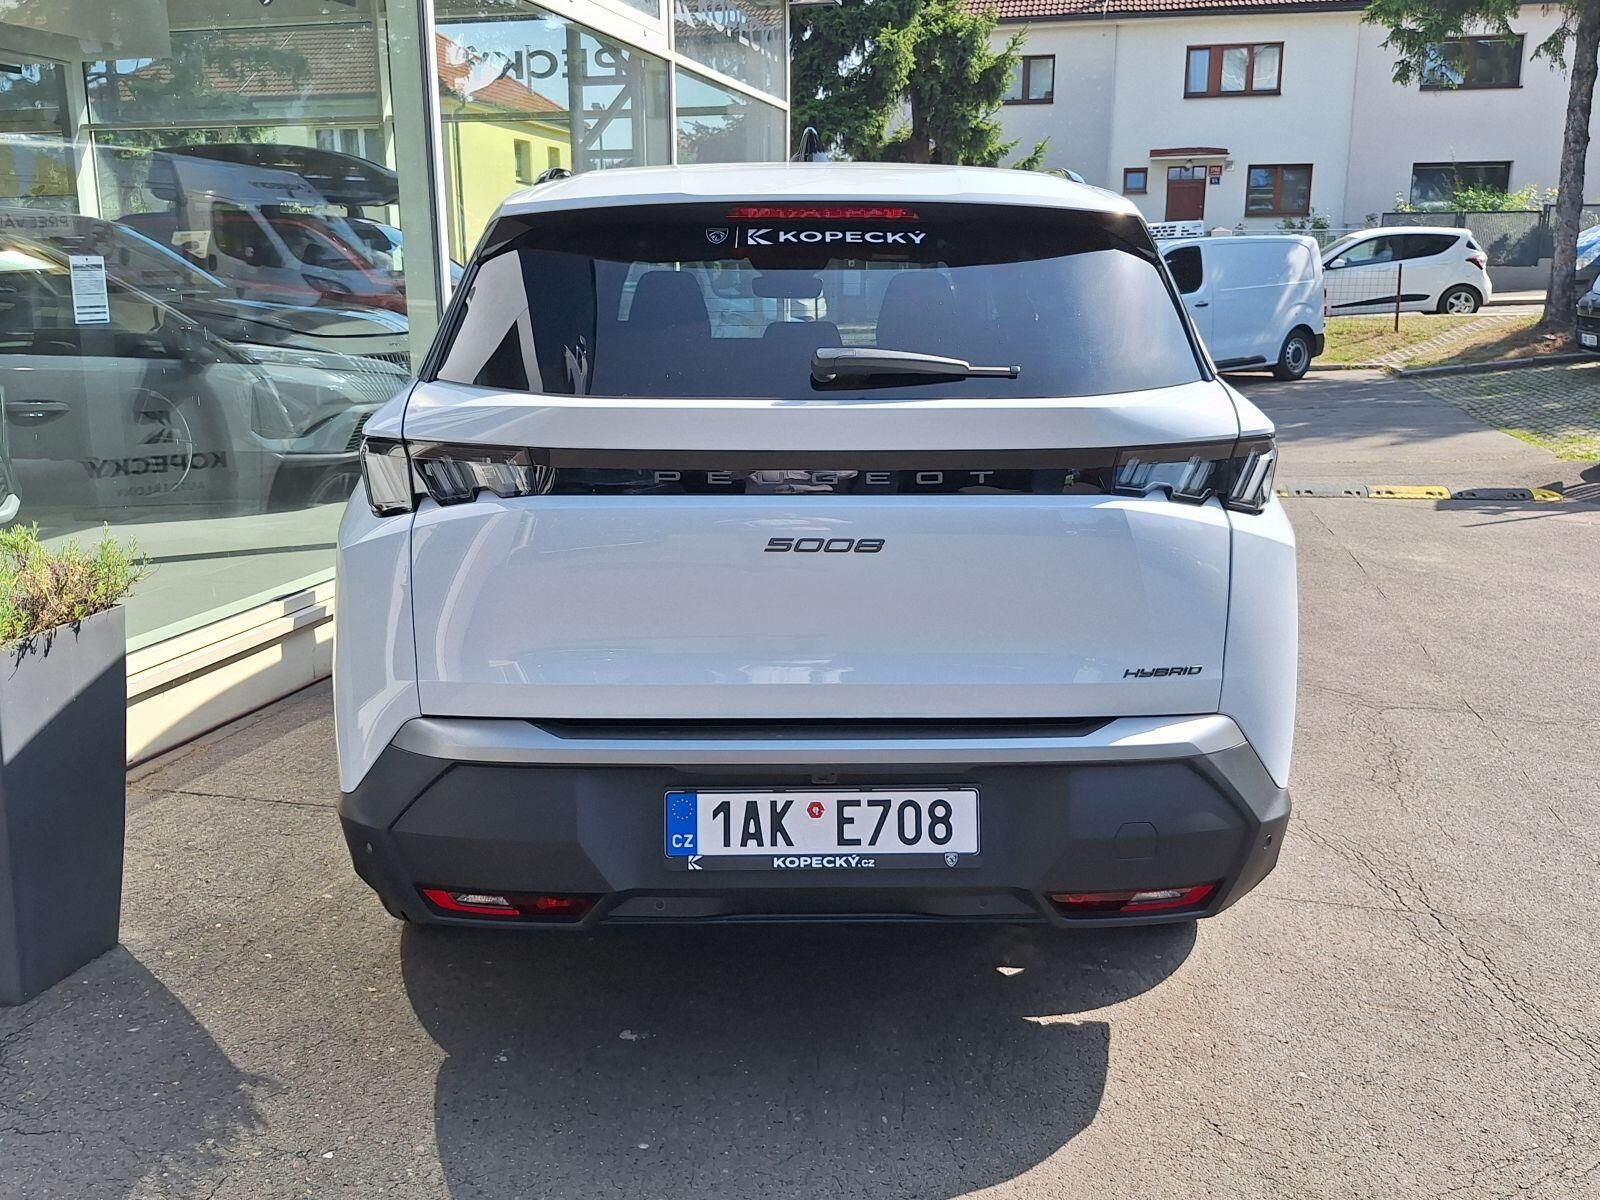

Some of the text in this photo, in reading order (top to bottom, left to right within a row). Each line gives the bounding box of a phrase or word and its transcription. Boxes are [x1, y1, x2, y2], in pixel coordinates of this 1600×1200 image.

[779, 230, 927, 245] KOPECKÝ
[654, 470, 995, 485] PEUGEOT
[764, 537, 886, 553] 5008
[1123, 665, 1203, 679] HYBRID
[712, 799, 953, 848] 1AK E708
[672, 834, 694, 848] CZ
